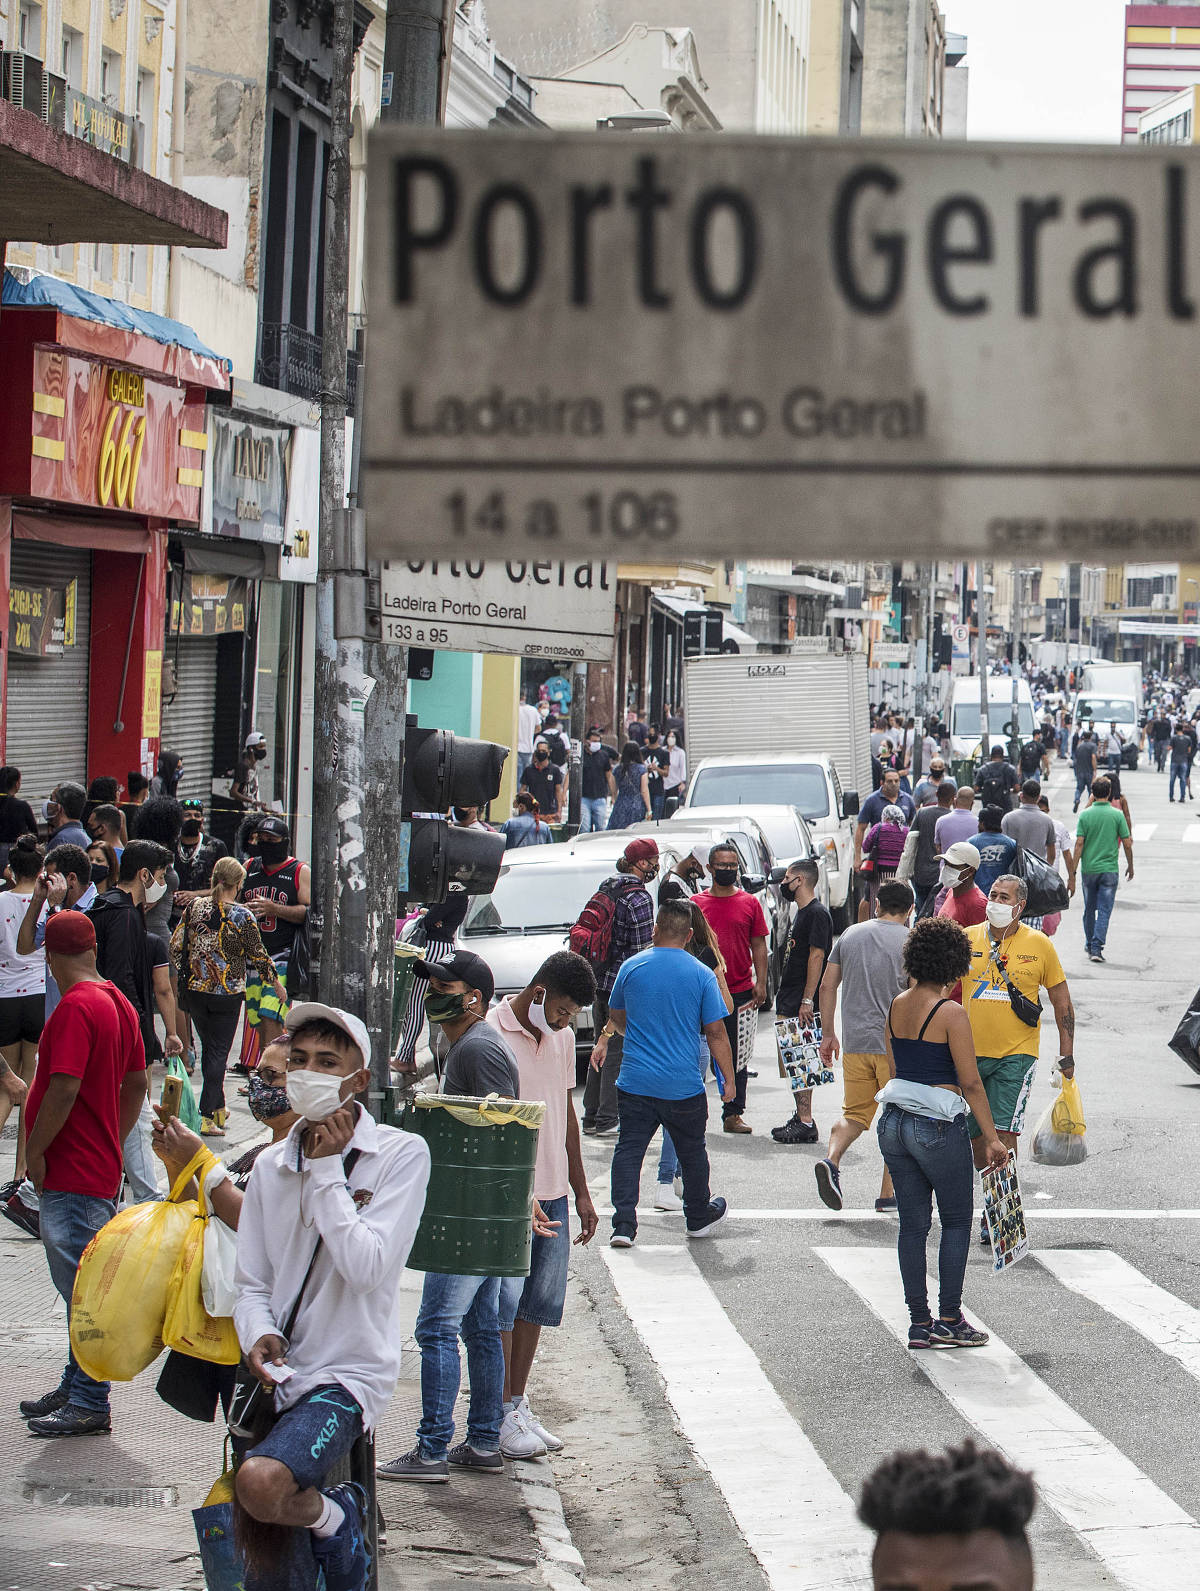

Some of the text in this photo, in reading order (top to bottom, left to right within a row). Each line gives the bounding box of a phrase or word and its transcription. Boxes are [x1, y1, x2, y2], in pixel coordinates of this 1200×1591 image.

[91, 107, 129, 148] HOOKAH
[392, 155, 1197, 320] Porto Geral
[109, 369, 145, 408] GALERIA
[402, 383, 927, 441] Ladeira Porto Geral
[98, 406, 146, 509] 661
[445, 489, 681, 542] 14 a 106
[384, 593, 526, 620] Ladeira Porto Geral
[387, 624, 448, 643] 133 a 95
[524, 644, 584, 657] CEP 01022-000
[749, 665, 785, 673] ROTA
